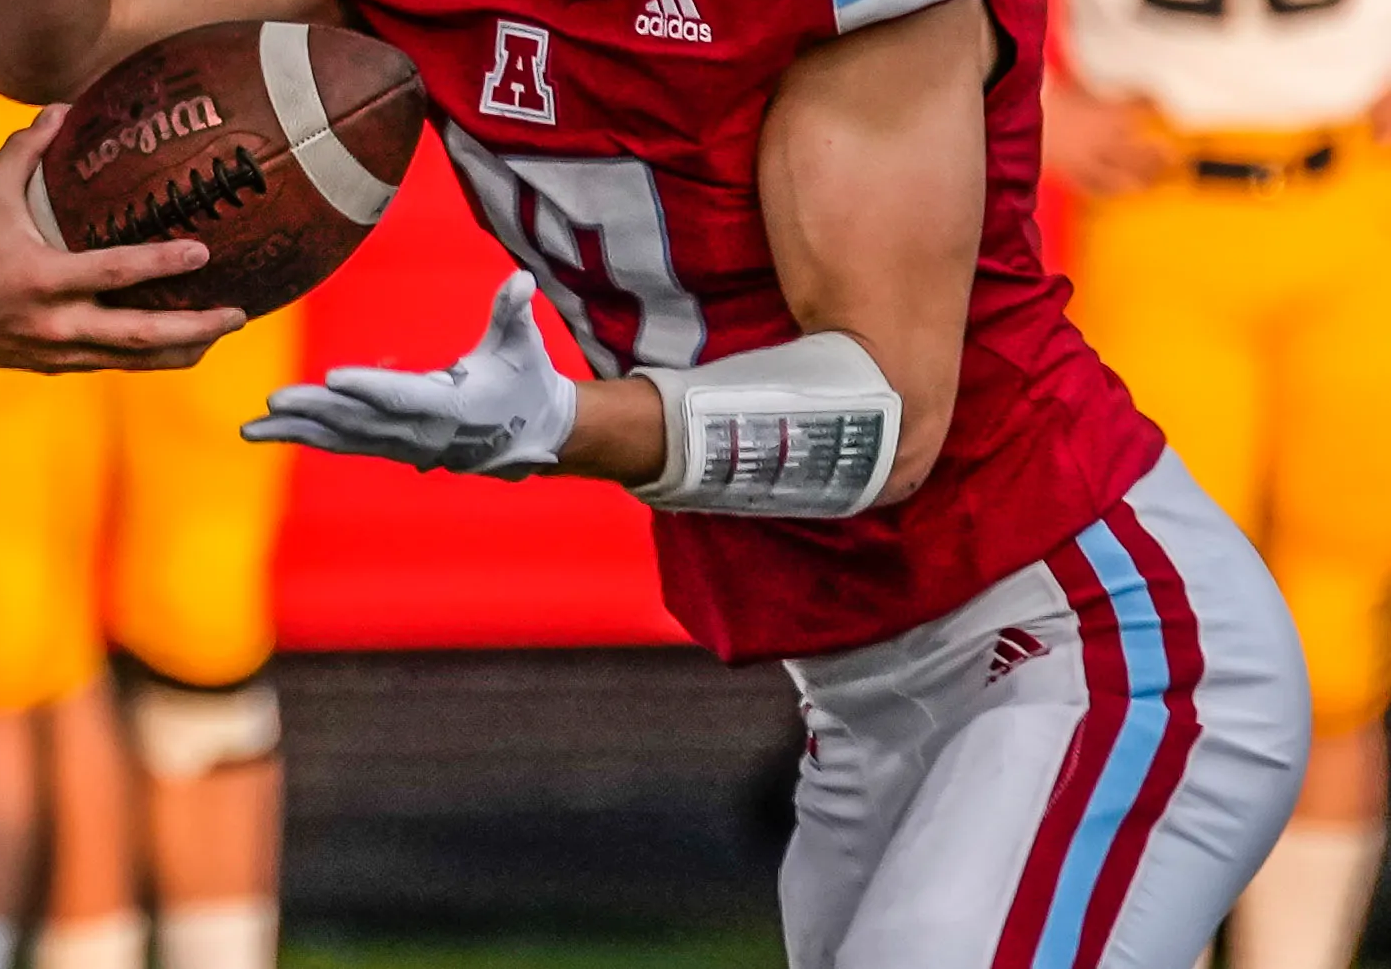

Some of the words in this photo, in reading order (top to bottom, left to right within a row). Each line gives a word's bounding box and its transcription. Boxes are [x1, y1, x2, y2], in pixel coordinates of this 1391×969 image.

[635, 14, 713, 43] adidas
[482, 23, 554, 122] A
[75, 95, 223, 181] Wilson
